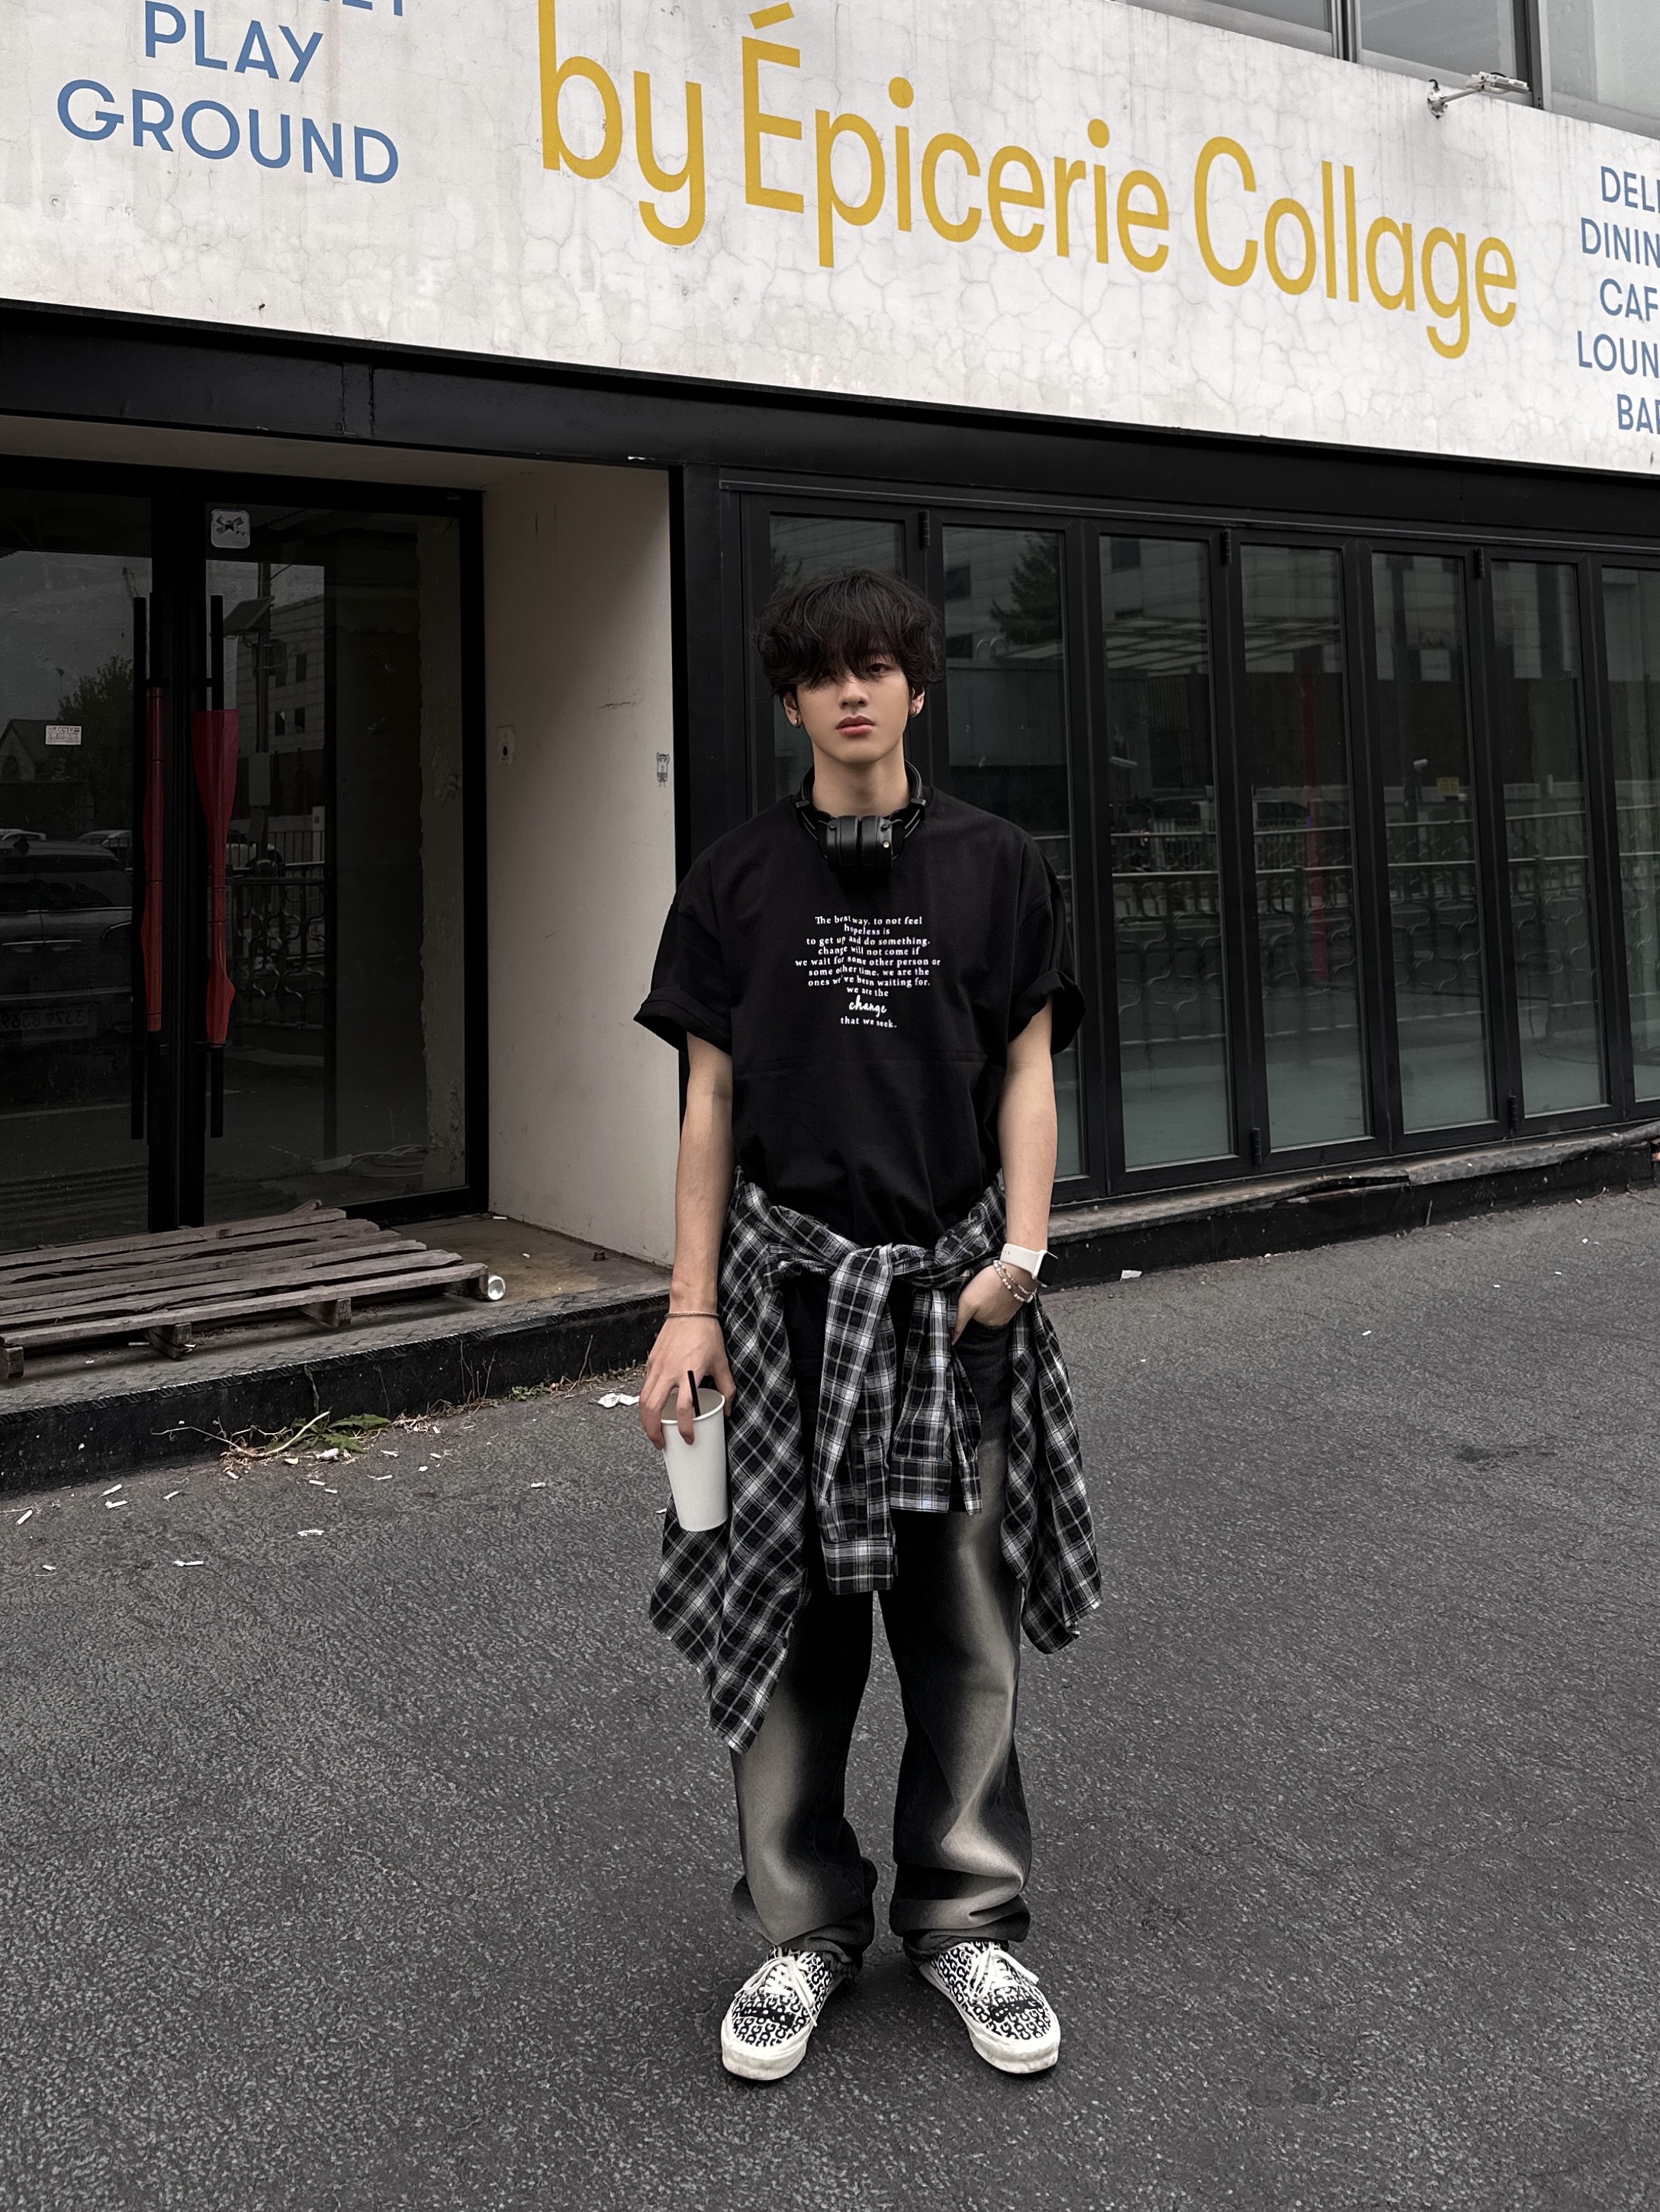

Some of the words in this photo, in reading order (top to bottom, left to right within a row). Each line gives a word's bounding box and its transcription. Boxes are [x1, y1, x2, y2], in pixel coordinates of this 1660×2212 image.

[144, 0, 323, 83] PLAY
[57, 79, 398, 184] GROUND
[537, 0, 706, 246] by
[742, 2, 1173, 273] Épicerie
[1194, 136, 1517, 359] Collage
[815, 915, 832, 924] The
[873, 917, 883, 925] to
[904, 915, 922, 925] feel
[844, 923, 880, 936] hopeless
[819, 937, 834, 947] get
[836, 936, 846, 945] up
[848, 935, 861, 945] and
[864, 936, 876, 946] do
[818, 945, 848, 956] change
[850, 946, 864, 955] will
[866, 948, 883, 956] not
[912, 946, 921, 956] if
[810, 957, 831, 966] wait
[833, 956, 844, 965] for
[847, 956, 867, 966] some
[869, 956, 894, 966] other
[896, 959, 929, 969] person
[835, 963, 857, 975] other
[915, 966, 930, 976] the
[877, 978, 912, 989] waiting
[915, 976, 931, 986] for.
[861, 988, 873, 996] are
[874, 988, 889, 997] the
[848, 994, 887, 1018] change
[841, 1015, 860, 1025] that
[877, 1019, 897, 1028] seek.
